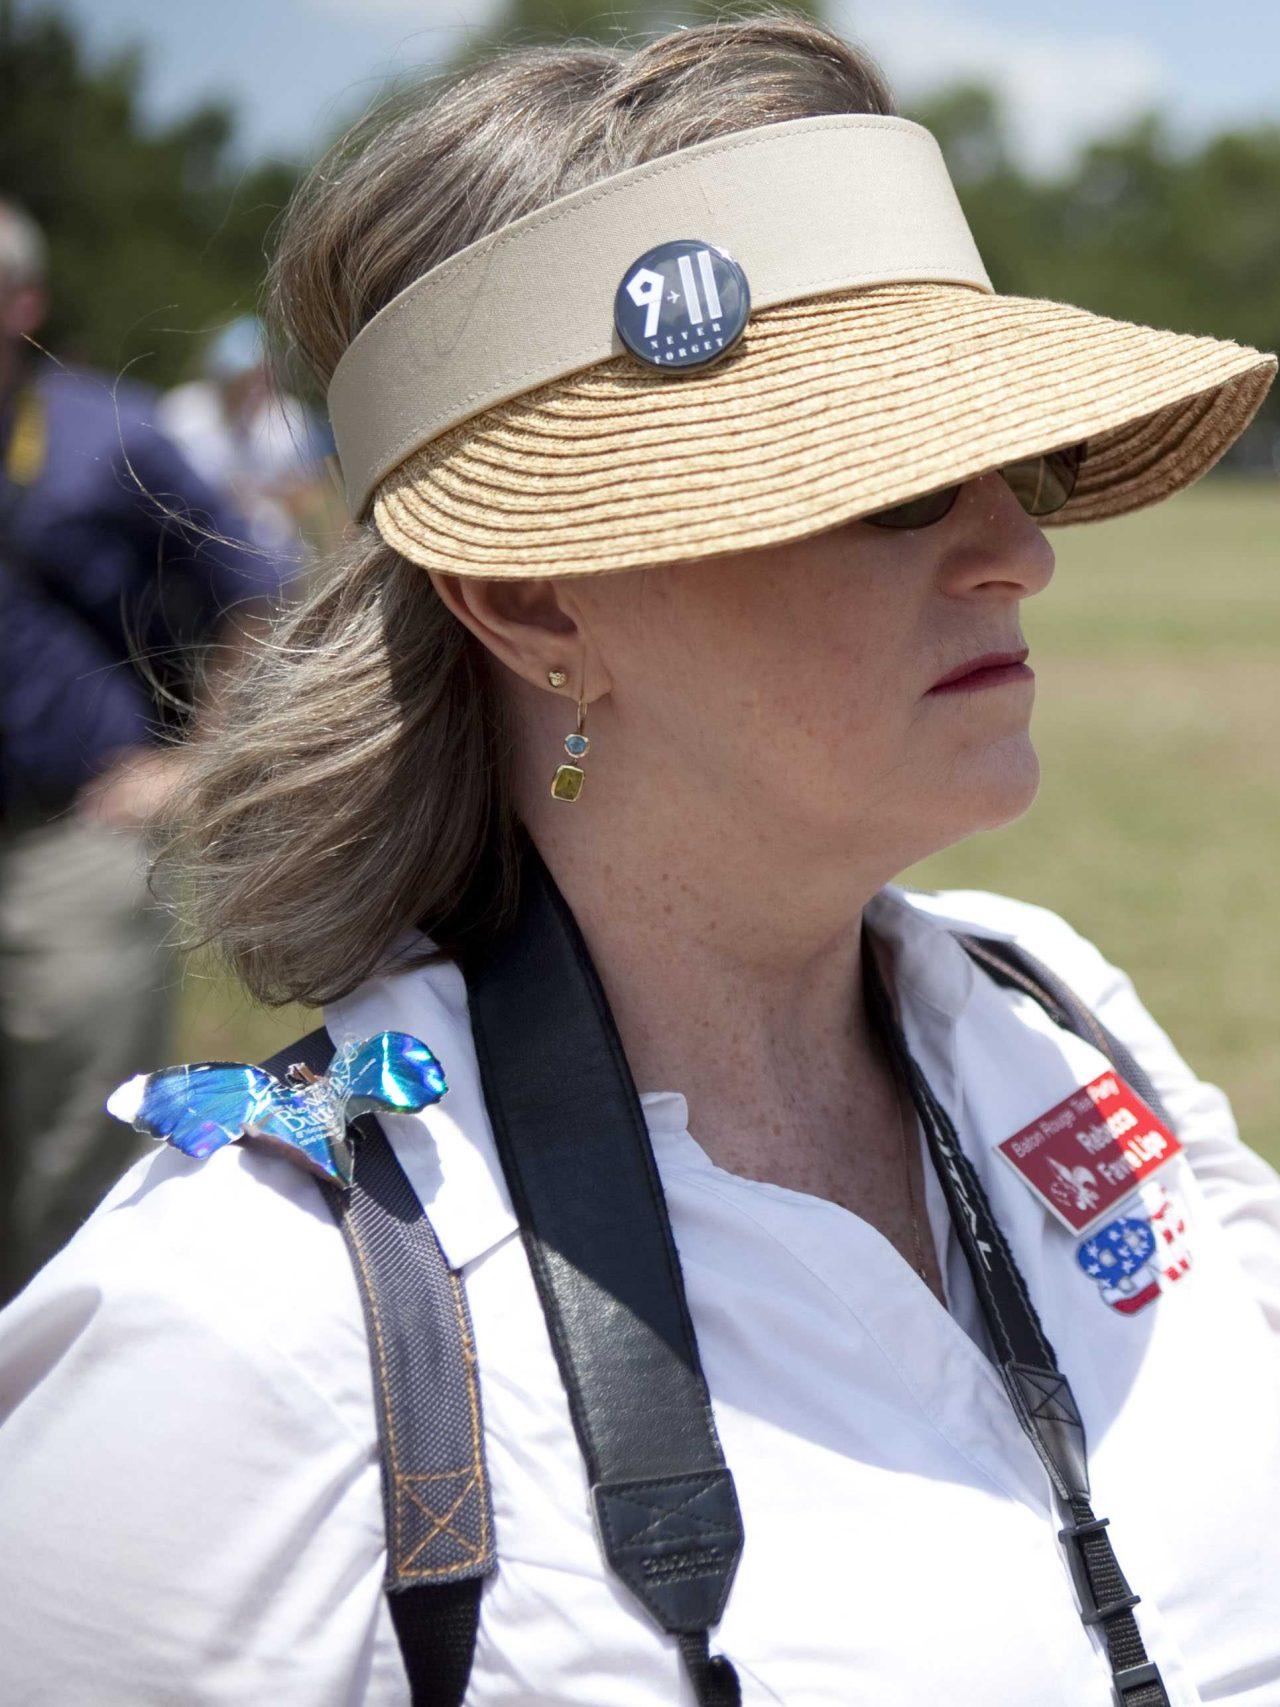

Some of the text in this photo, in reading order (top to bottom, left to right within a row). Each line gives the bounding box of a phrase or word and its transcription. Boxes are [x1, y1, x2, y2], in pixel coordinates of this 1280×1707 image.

[651, 323, 721, 349] NEVER
[654, 338, 723, 364] FORGET
[1010, 1130, 1046, 1159] Baton
[1039, 1109, 1077, 1138] Rouge
